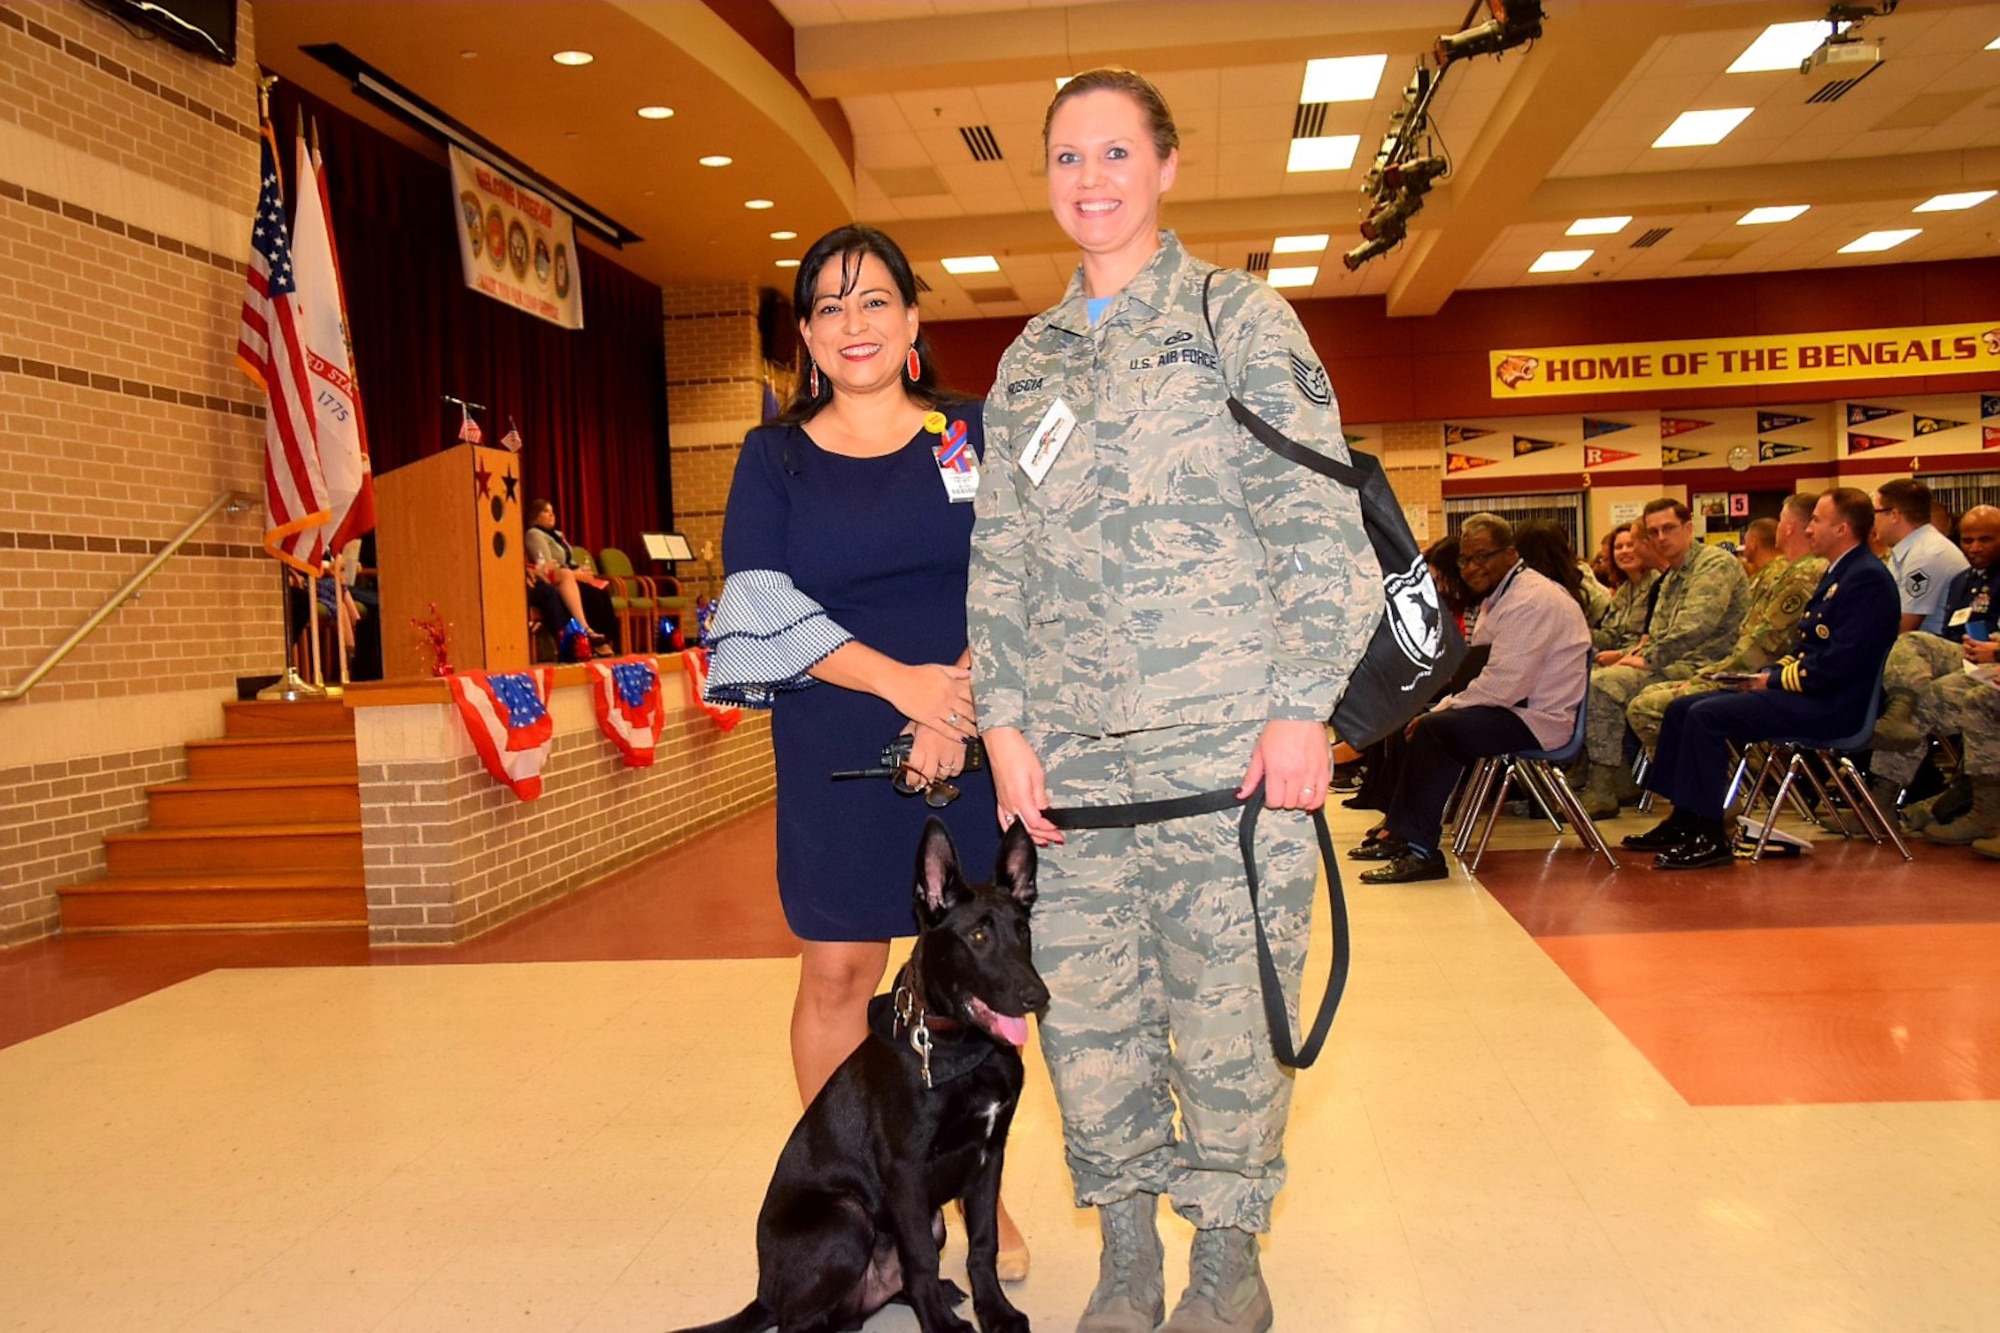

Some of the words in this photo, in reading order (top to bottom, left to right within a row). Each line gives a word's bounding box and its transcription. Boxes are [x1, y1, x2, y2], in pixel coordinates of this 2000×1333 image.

[1129, 358, 1154, 370] U.S.
[1157, 350, 1178, 367] AIR
[1181, 348, 1217, 370] FORCE
[1545, 355, 1652, 382] HOME
[1662, 352, 1708, 376] OF
[1717, 347, 1788, 373] THE
[1798, 336, 1977, 369] BENGALS
[317, 390, 349, 422] 1775
[1586, 448, 1603, 465] R
[1662, 449, 1680, 463] M
[1909, 456, 1920, 471] 4
[1582, 473, 1592, 487] 3
[1735, 498, 1744, 511] 5
